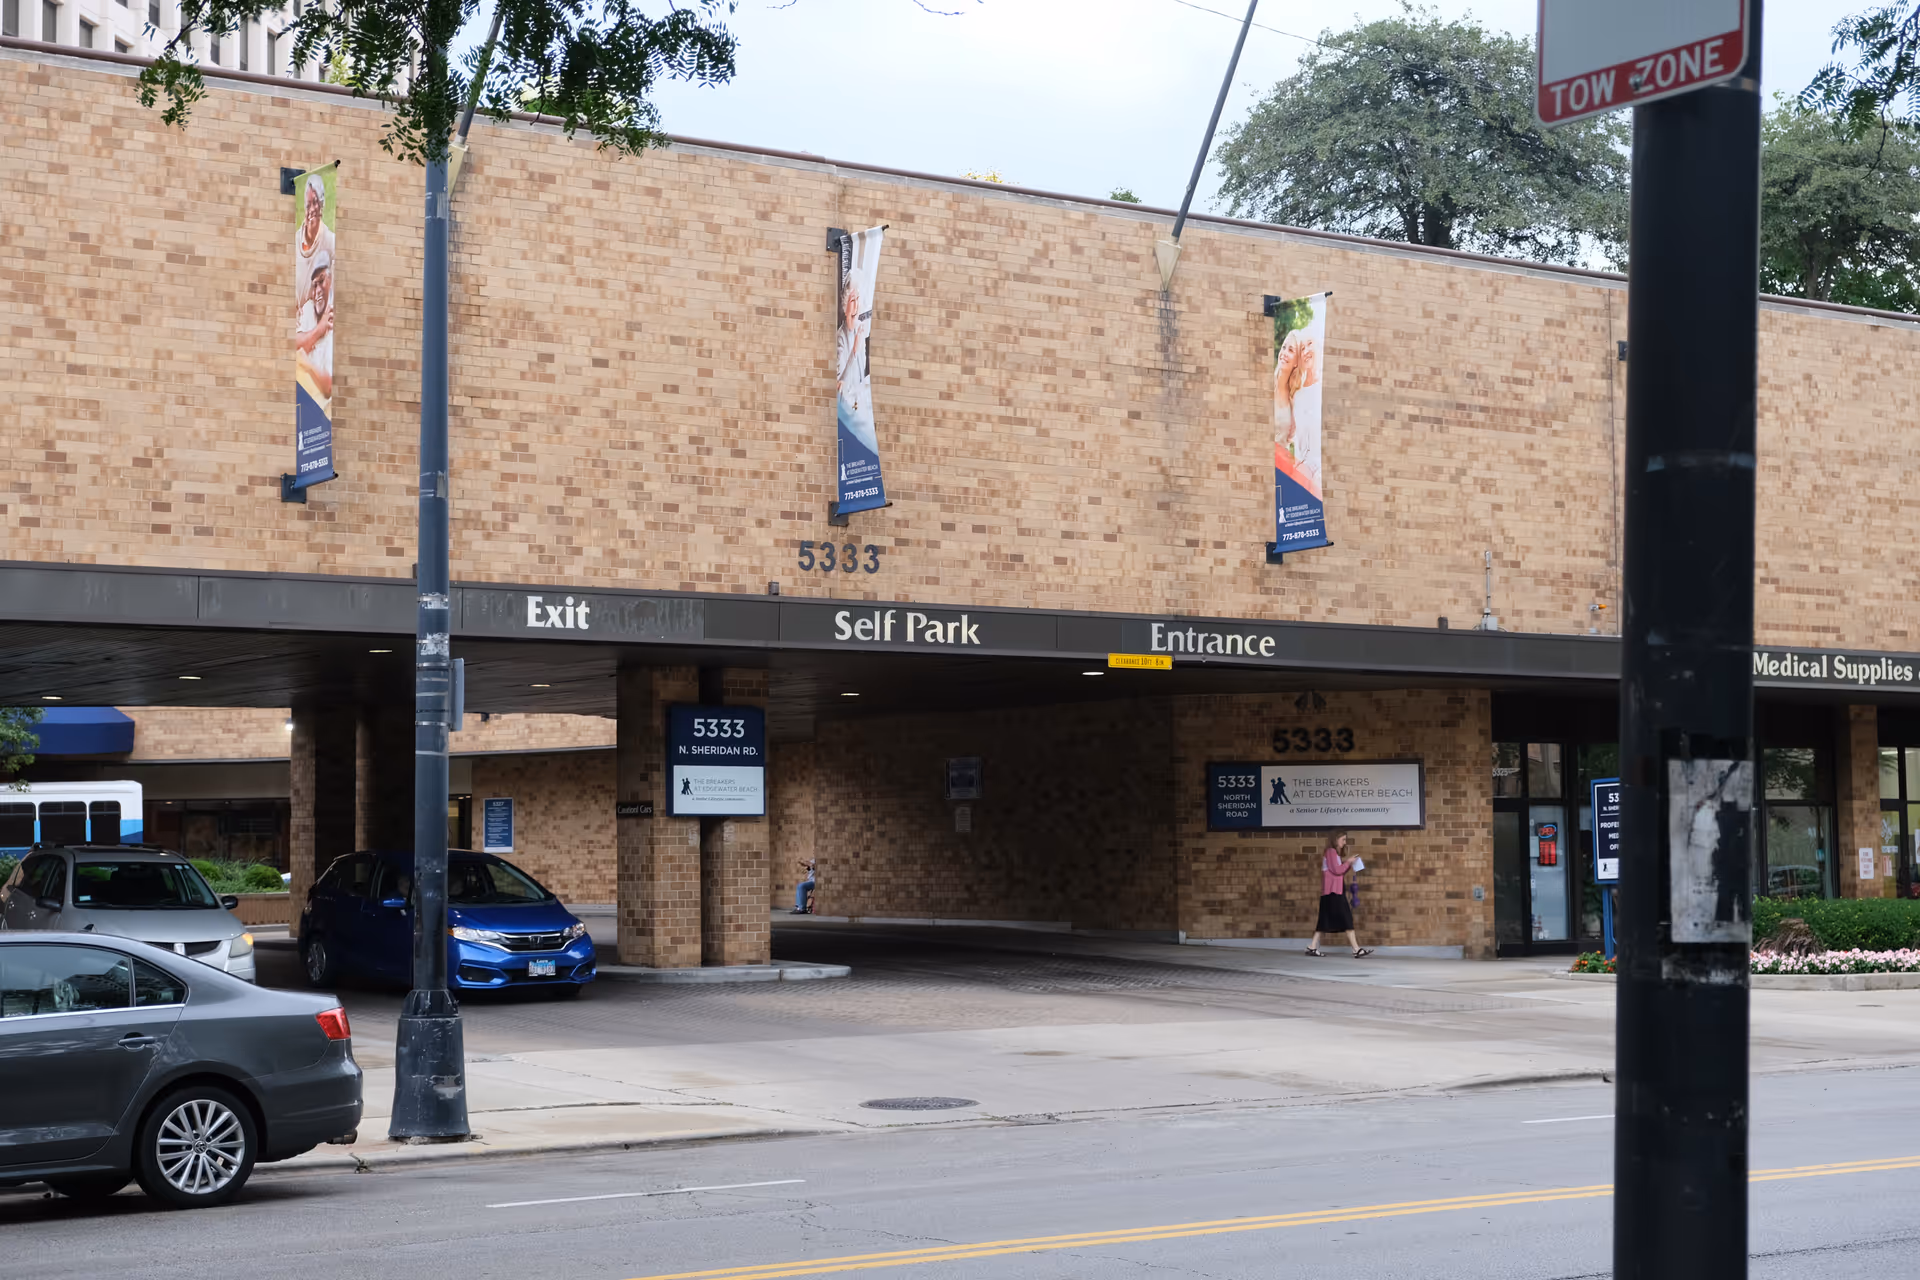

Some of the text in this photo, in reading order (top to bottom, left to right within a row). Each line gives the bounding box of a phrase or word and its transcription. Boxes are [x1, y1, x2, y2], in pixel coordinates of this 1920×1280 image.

[1550, 38, 1724, 116] TOW ZONE
[798, 540, 880, 574] 5333
[527, 596, 590, 630] Exit
[834, 609, 981, 644] Self Park
[1151, 623, 1276, 657] Entrance
[1752, 652, 1828, 678] Medical
[1834, 655, 1913, 685] Supplies
[693, 718, 745, 738] 5333
[1272, 727, 1355, 754] 5333
[679, 745, 759, 756] N. SHERIDAN RD.
[1217, 775, 1256, 788] 5333
[1292, 778, 1370, 787] THE BREAKERS
[1292, 788, 1413, 799] AT EDGEWATER BEACH
[1320, 806, 1350, 814] Lifestyle
